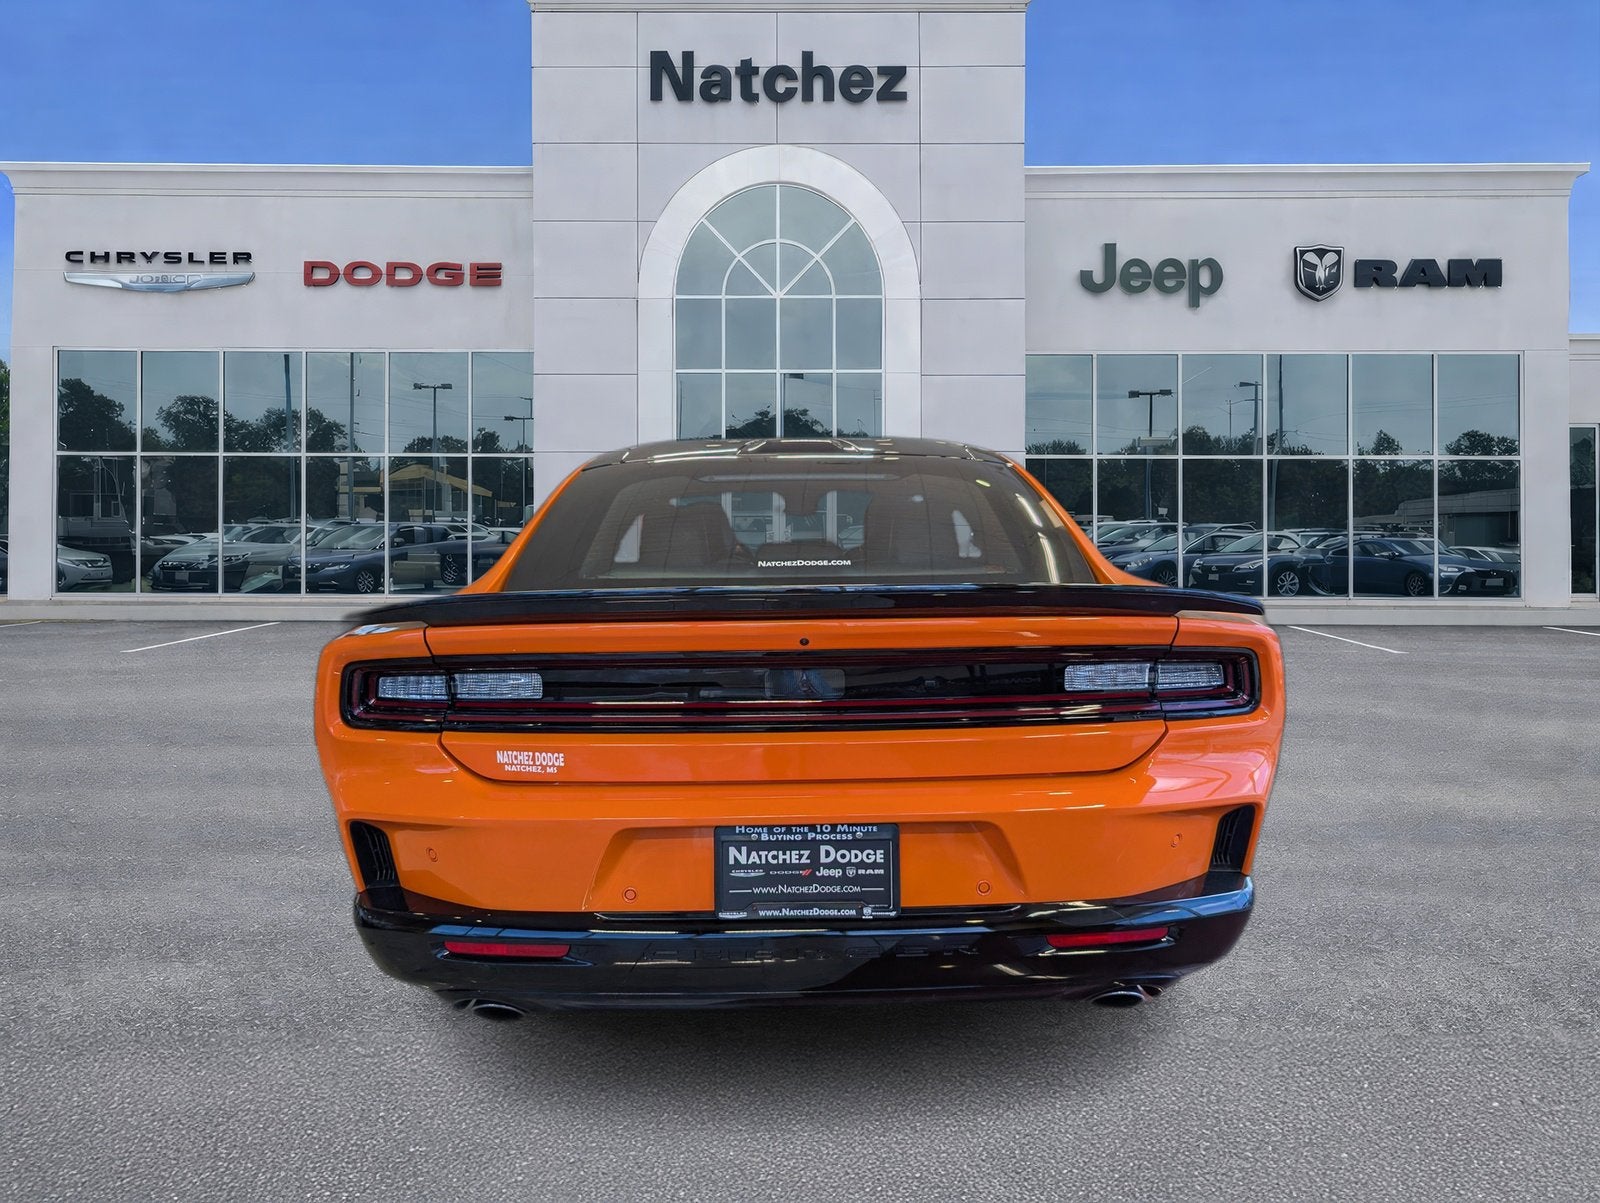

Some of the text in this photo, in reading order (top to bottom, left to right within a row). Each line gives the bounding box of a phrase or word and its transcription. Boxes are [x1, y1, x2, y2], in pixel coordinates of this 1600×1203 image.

[650, 51, 908, 104] Natchez
[65, 251, 252, 264] CHRYSLER
[304, 261, 502, 287] DODGE
[1080, 243, 1224, 308] Jeep
[1354, 258, 1502, 288] RAM
[496, 750, 565, 766] NATCHEZ DODGE
[504, 764, 545, 773] NATCHEZ,
[735, 825, 768, 834] HOME
[773, 826, 785, 834] OF
[815, 824, 831, 832] 10
[836, 824, 878, 832] MINUTE
[761, 832, 853, 841] BUYING PROCESS
[728, 845, 884, 865] NATCHEZ DODGE
[816, 867, 842, 878] Jeep
